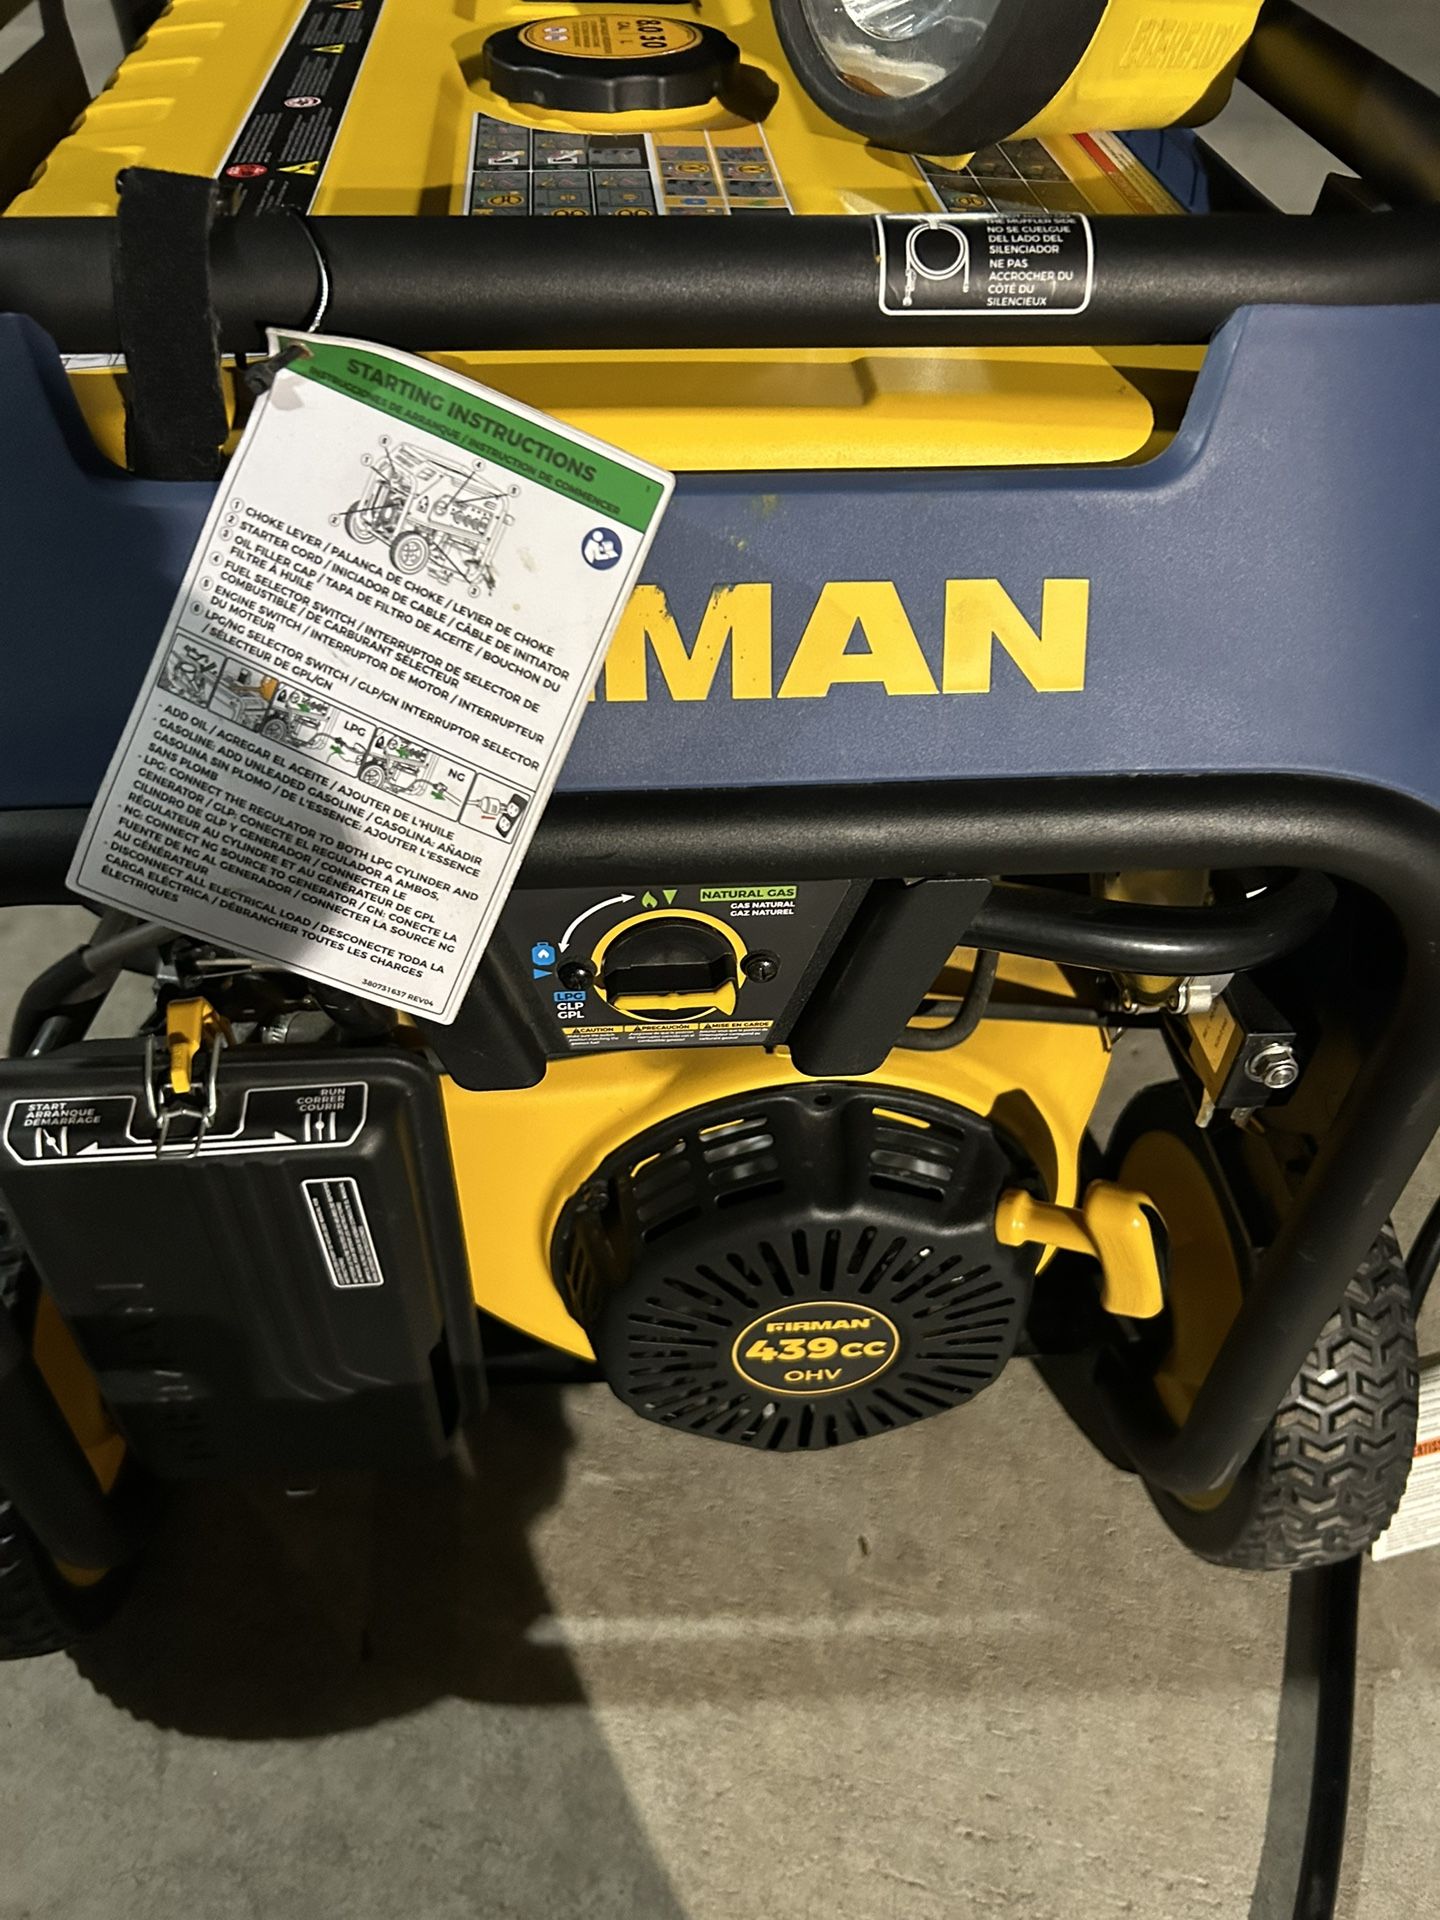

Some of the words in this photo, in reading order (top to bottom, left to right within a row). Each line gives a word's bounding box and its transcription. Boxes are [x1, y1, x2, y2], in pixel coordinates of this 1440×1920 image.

[988, 235, 1009, 243] DEL
[1011, 235, 1041, 243] LADO
[1043, 235, 1064, 243] DEL
[989, 245, 1060, 254] SILENCIADOR
[989, 259, 1005, 268] NE
[1007, 259, 1029, 268] PAS
[988, 271, 1055, 281] ACCROCHER
[1057, 271, 1074, 280] DU
[987, 282, 1016, 294] CÔTÉ
[1018, 285, 1035, 294] DU
[987, 297, 1047, 306] SILENCIEUX
[348, 355, 445, 412] STARTING
[447, 402, 597, 482] INSTRUCTIONS
[230, 546, 267, 569] FILTRE
[280, 569, 314, 591] HUILE
[245, 507, 284, 531] CHOKE
[286, 525, 322, 548] LEVER
[331, 546, 383, 577] PALANCA
[386, 571, 403, 586] DE
[404, 580, 444, 605] CHOKE
[452, 602, 493, 628] LEVIER
[495, 622, 512, 637] DE
[514, 632, 555, 657] CHOKE
[240, 521, 289, 550] STARTER
[291, 545, 323, 565] CORD
[331, 563, 390, 597] INICIADOR
[391, 591, 408, 605] DE
[410, 600, 447, 624] CABLE
[494, 639, 512, 654] DE
[513, 648, 570, 680] INITIATOR
[210, 595, 228, 609] DU
[228, 604, 276, 632] MOTEUR
[220, 571, 298, 613] COMBUSTIBLE
[305, 610, 323, 624] DE
[324, 619, 394, 657] CARBURANT
[234, 535, 252, 550] OIL
[254, 544, 291, 568] FILLER
[293, 563, 317, 577] CAP
[326, 576, 353, 597] TAPA
[356, 591, 373, 606] DE
[374, 600, 413, 624] FILTRO
[415, 619, 432, 633] DE
[432, 628, 474, 653] ACEITE
[482, 650, 541, 684] BOUCHON
[542, 678, 561, 692] DU
[224, 560, 250, 579] FUEL
[254, 574, 310, 606] SELECTOR
[312, 601, 357, 627] SWITCH
[364, 625, 443, 668] INTERRUPTOR
[444, 662, 462, 677] DE
[463, 671, 521, 704] SELECTOR
[523, 699, 540, 713] DE
[585, 578, 1091, 702] MAN
[214, 585, 257, 610] ENGINE
[258, 605, 302, 632] SWITCH
[310, 629, 388, 672] INTERRUPTOR
[390, 666, 406, 680] DE
[408, 675, 449, 700] MOTOR
[458, 698, 544, 744] INTERRUPTEUR
[273, 656, 290, 670] DE
[291, 666, 333, 690] GPL/GN
[204, 609, 246, 634] LPG/NG
[247, 629, 304, 662] SELECTOR
[305, 656, 349, 683] SWITCH
[358, 681, 399, 706] GLP/GN
[401, 701, 480, 744] INTERRUPTOR
[482, 738, 540, 771] SELECTOR
[344, 721, 366, 737] LPG
[164, 705, 189, 721] ADD
[190, 716, 208, 732] OIL
[216, 729, 271, 760] AGREGAR
[272, 754, 285, 768] EL
[288, 763, 330, 787] ACEITE
[337, 785, 391, 814] AJOUTER
[393, 808, 410, 822] DE
[448, 768, 466, 782] NG
[153, 730, 208, 763] GASOLINA
[210, 757, 230, 772] SIN
[231, 766, 272, 791] PLOMO
[280, 788, 298, 803] DE
[363, 826, 418, 853] AJOUTER
[217, 746, 243, 763] ADD
[244, 757, 306, 791] UNLEADED
[307, 787, 365, 818] GASOLINE
[374, 816, 435, 847] GASOLINA:
[702, 890, 764, 899] NATURAL
[767, 889, 795, 897] GAS
[110, 841, 184, 878] DISCONNECT
[184, 874, 206, 888] ALL
[208, 882, 277, 915] ELECTRICAL
[279, 909, 312, 927] LOAD
[320, 924, 395, 957] DESCONECTE
[398, 952, 427, 968] TODA
[430, 963, 444, 973] LA
[752, 901, 796, 909] NATURAL
[752, 908, 794, 916] NATUREL
[105, 853, 145, 877] CARGA
[302, 929, 345, 951] TOUTES
[347, 946, 368, 959] LES
[370, 955, 423, 978] CHARGES
[362, 978, 407, 998] 380731637
[407, 994, 433, 1006] REV04
[557, 992, 583, 1001] LPG
[557, 1002, 584, 1011] GLP
[557, 1010, 585, 1019] GPL
[320, 1087, 346, 1096] RUN
[28, 1102, 68, 1111] START
[296, 1095, 346, 1105] CORRER
[299, 1102, 345, 1112] COURIR
[26, 1108, 96, 1118] ARRANQUE
[766, 1318, 871, 1333] FIRMAN
[744, 1336, 888, 1361] 439cc
[783, 1367, 842, 1382] OHV
